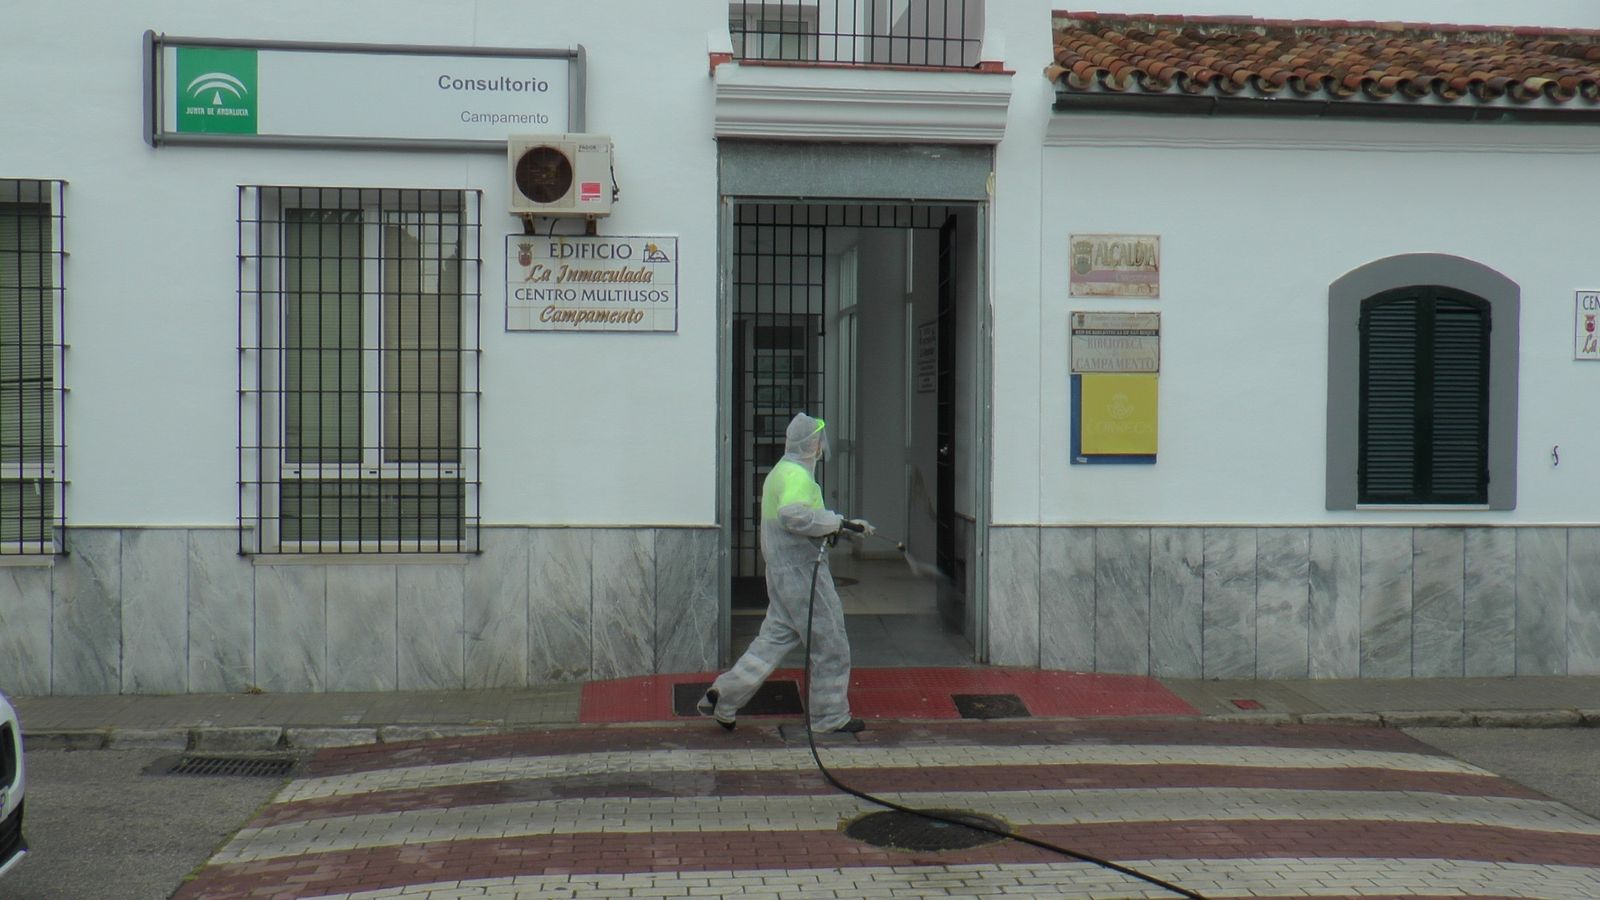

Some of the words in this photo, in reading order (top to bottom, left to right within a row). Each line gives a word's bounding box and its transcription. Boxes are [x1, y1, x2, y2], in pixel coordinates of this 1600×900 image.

[438, 74, 549, 92] Consultorio
[460, 110, 549, 125] Campamento
[549, 243, 633, 259] EDIFICIO
[525, 264, 552, 283] La
[556, 264, 654, 284] Inmaculada
[514, 288, 577, 301] CENTRO
[581, 289, 670, 303] MULTIUSOS
[539, 304, 645, 326] Campamento
[1076, 357, 1154, 370] CAMPAMENTO
